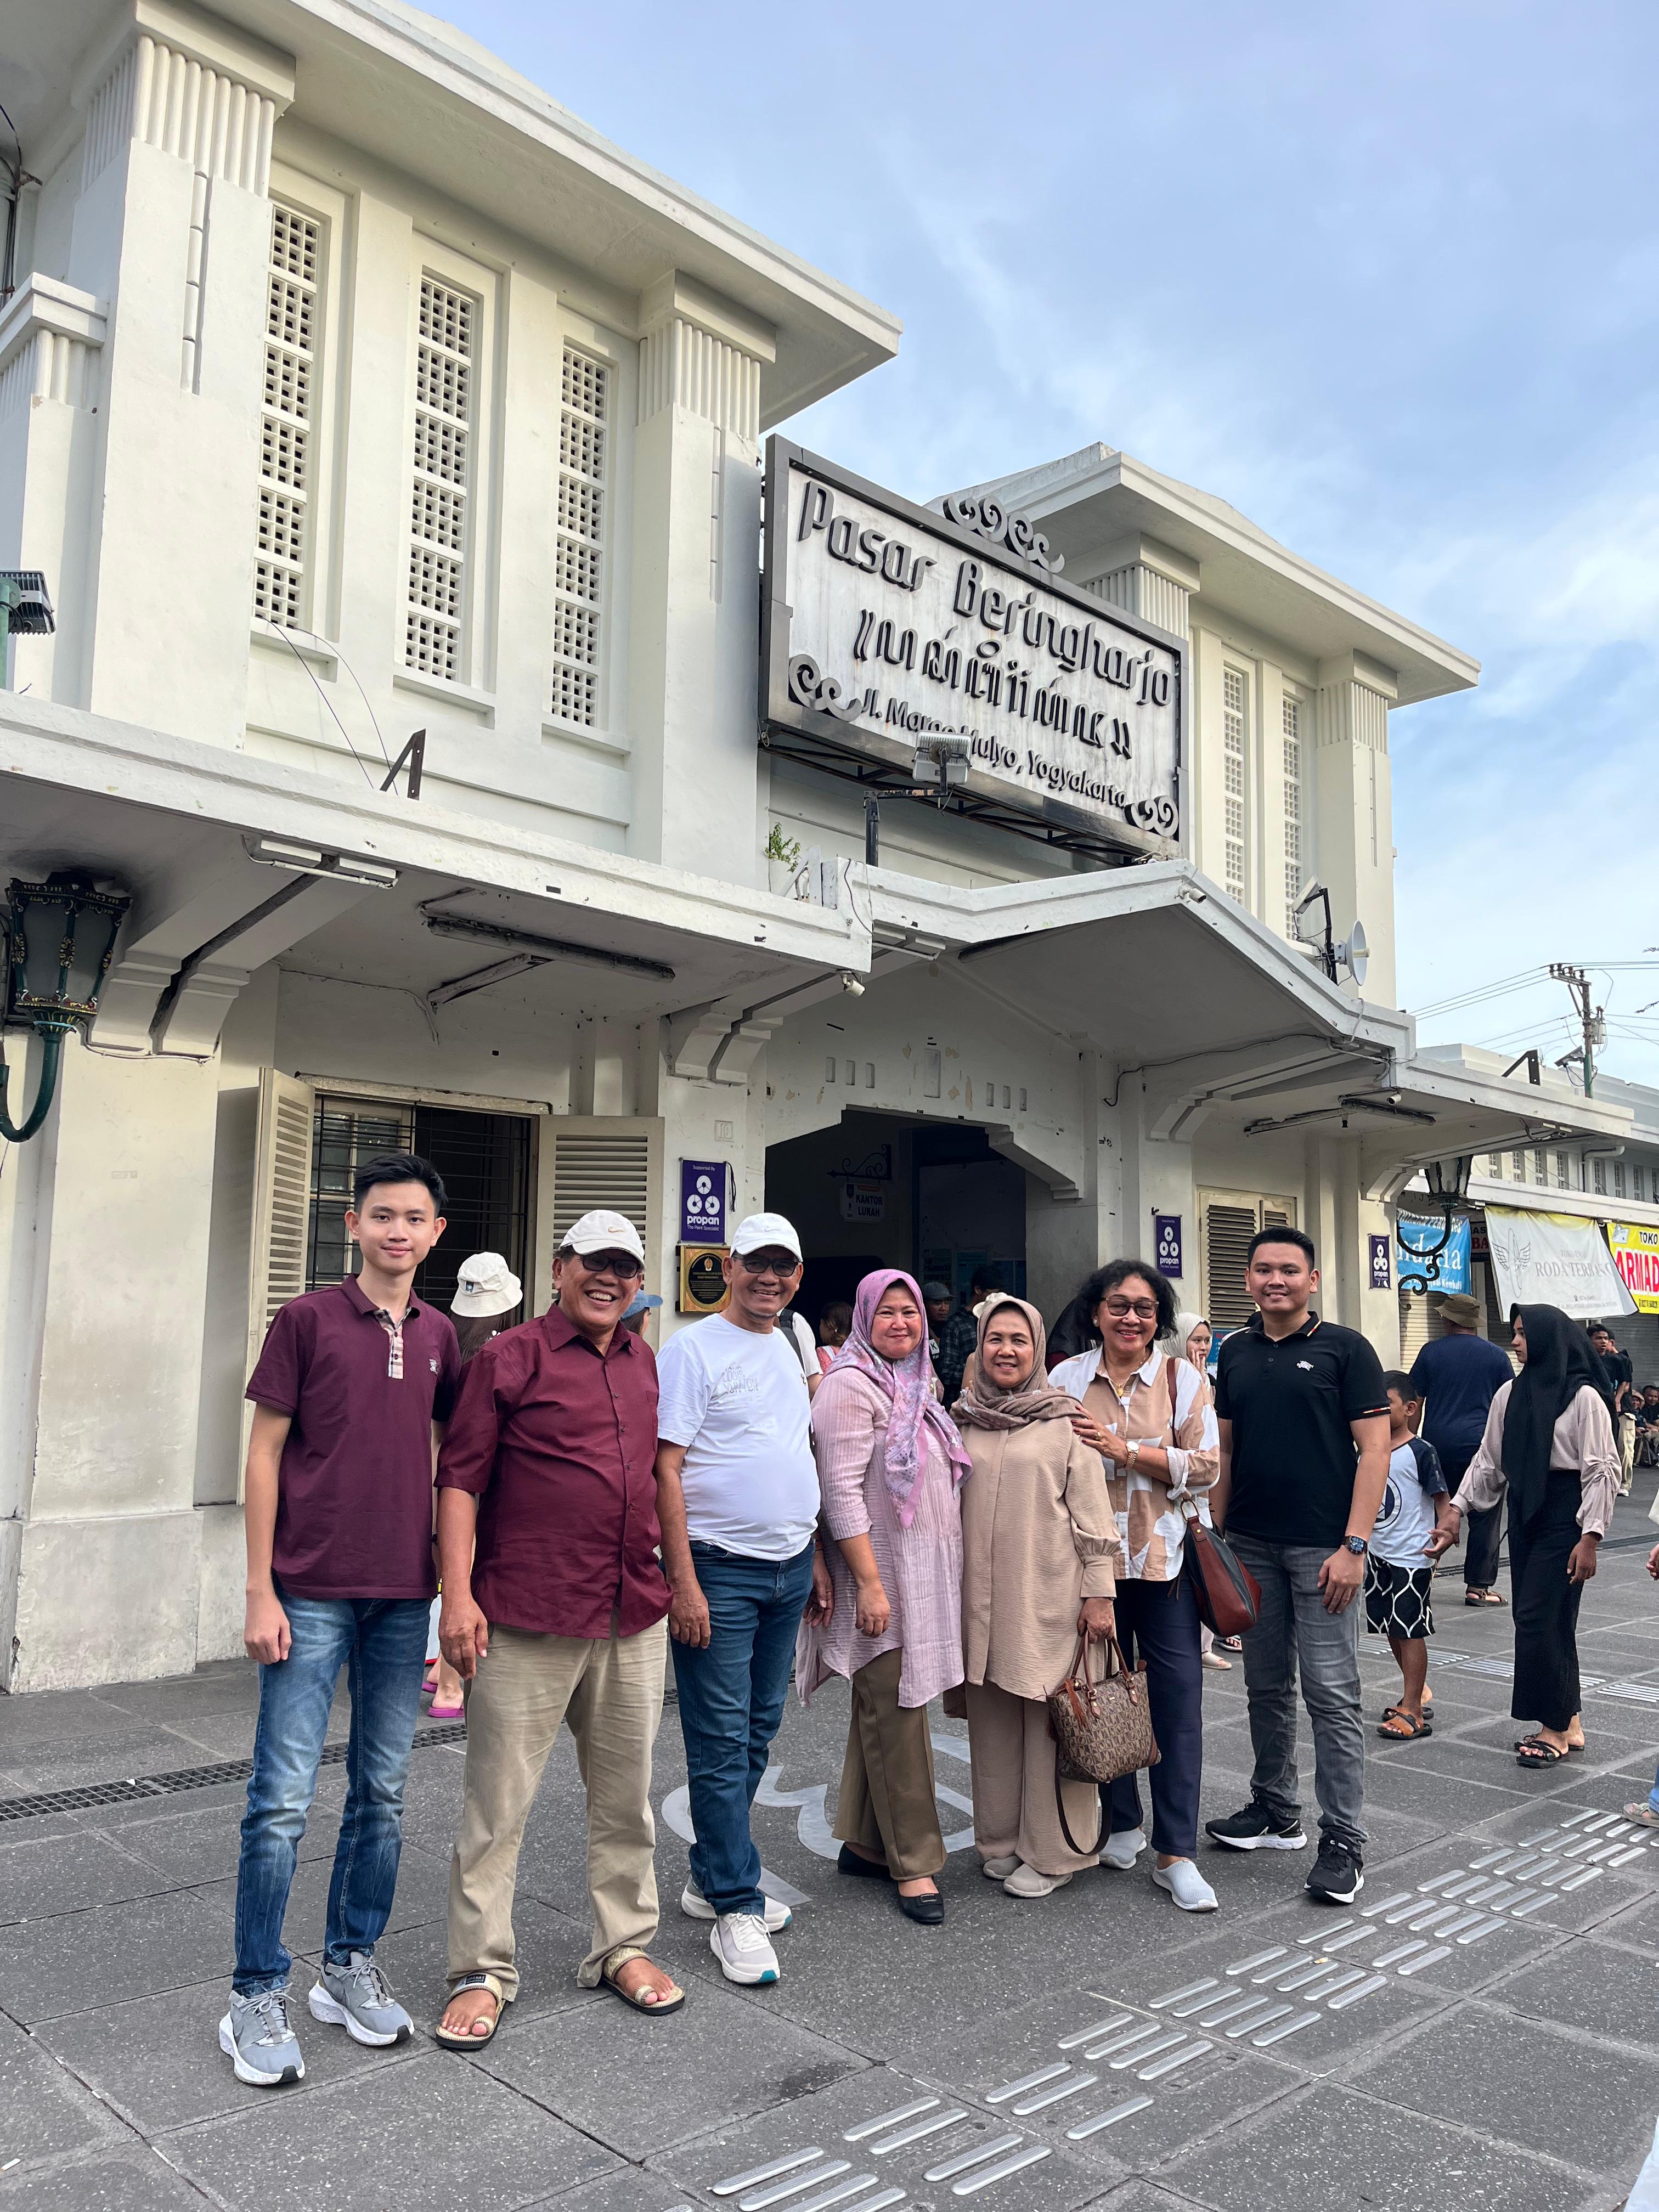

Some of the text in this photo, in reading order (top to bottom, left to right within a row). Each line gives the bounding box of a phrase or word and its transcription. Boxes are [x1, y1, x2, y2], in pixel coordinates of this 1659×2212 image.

[797, 480, 1173, 707] Pasar Beringharjo
[861, 688, 883, 719] Jl.
[1028, 749, 1126, 809] Yogyakarta
[856, 1194, 883, 1206] KANTOR
[858, 1206, 879, 1217] LURAH
[687, 1215, 720, 1226] propan
[1639, 1231, 1658, 1245] TOKO
[1536, 1262, 1568, 1277] RODA
